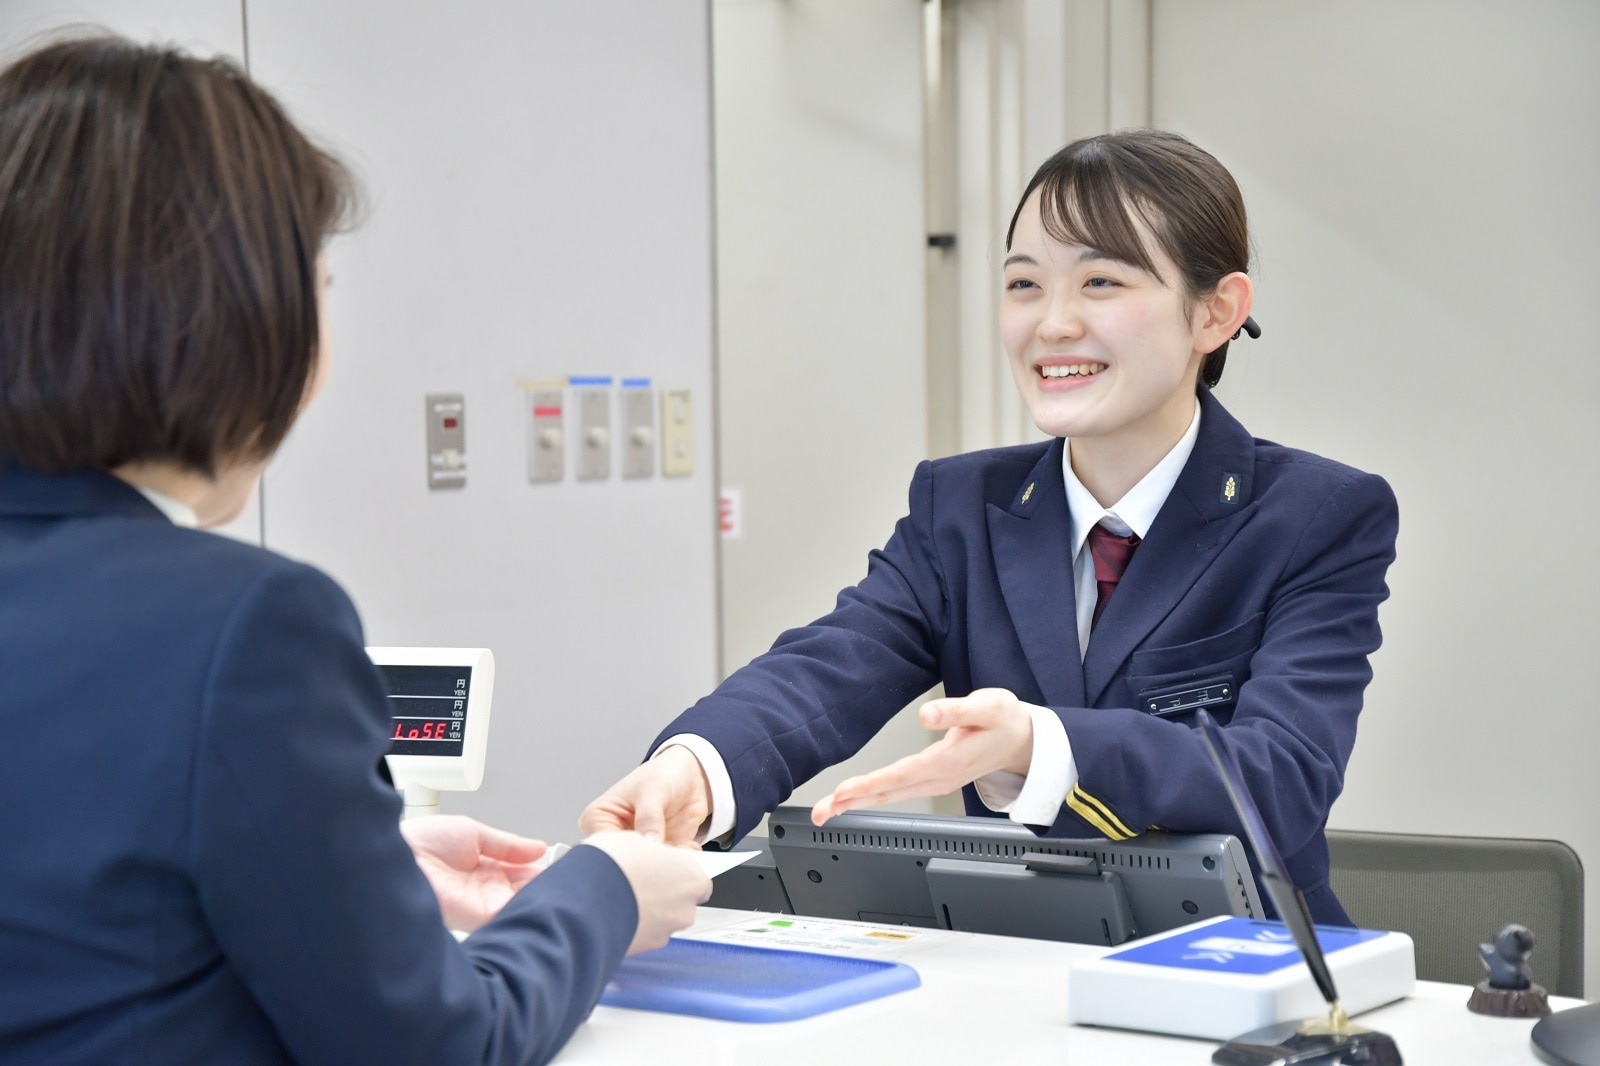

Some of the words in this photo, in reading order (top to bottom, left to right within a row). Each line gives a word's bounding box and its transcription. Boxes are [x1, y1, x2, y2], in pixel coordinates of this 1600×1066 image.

[456, 678, 466, 689] 円
[453, 700, 463, 710] 円
[393, 722, 447, 740] LoSE
[451, 721, 461, 731] 円
